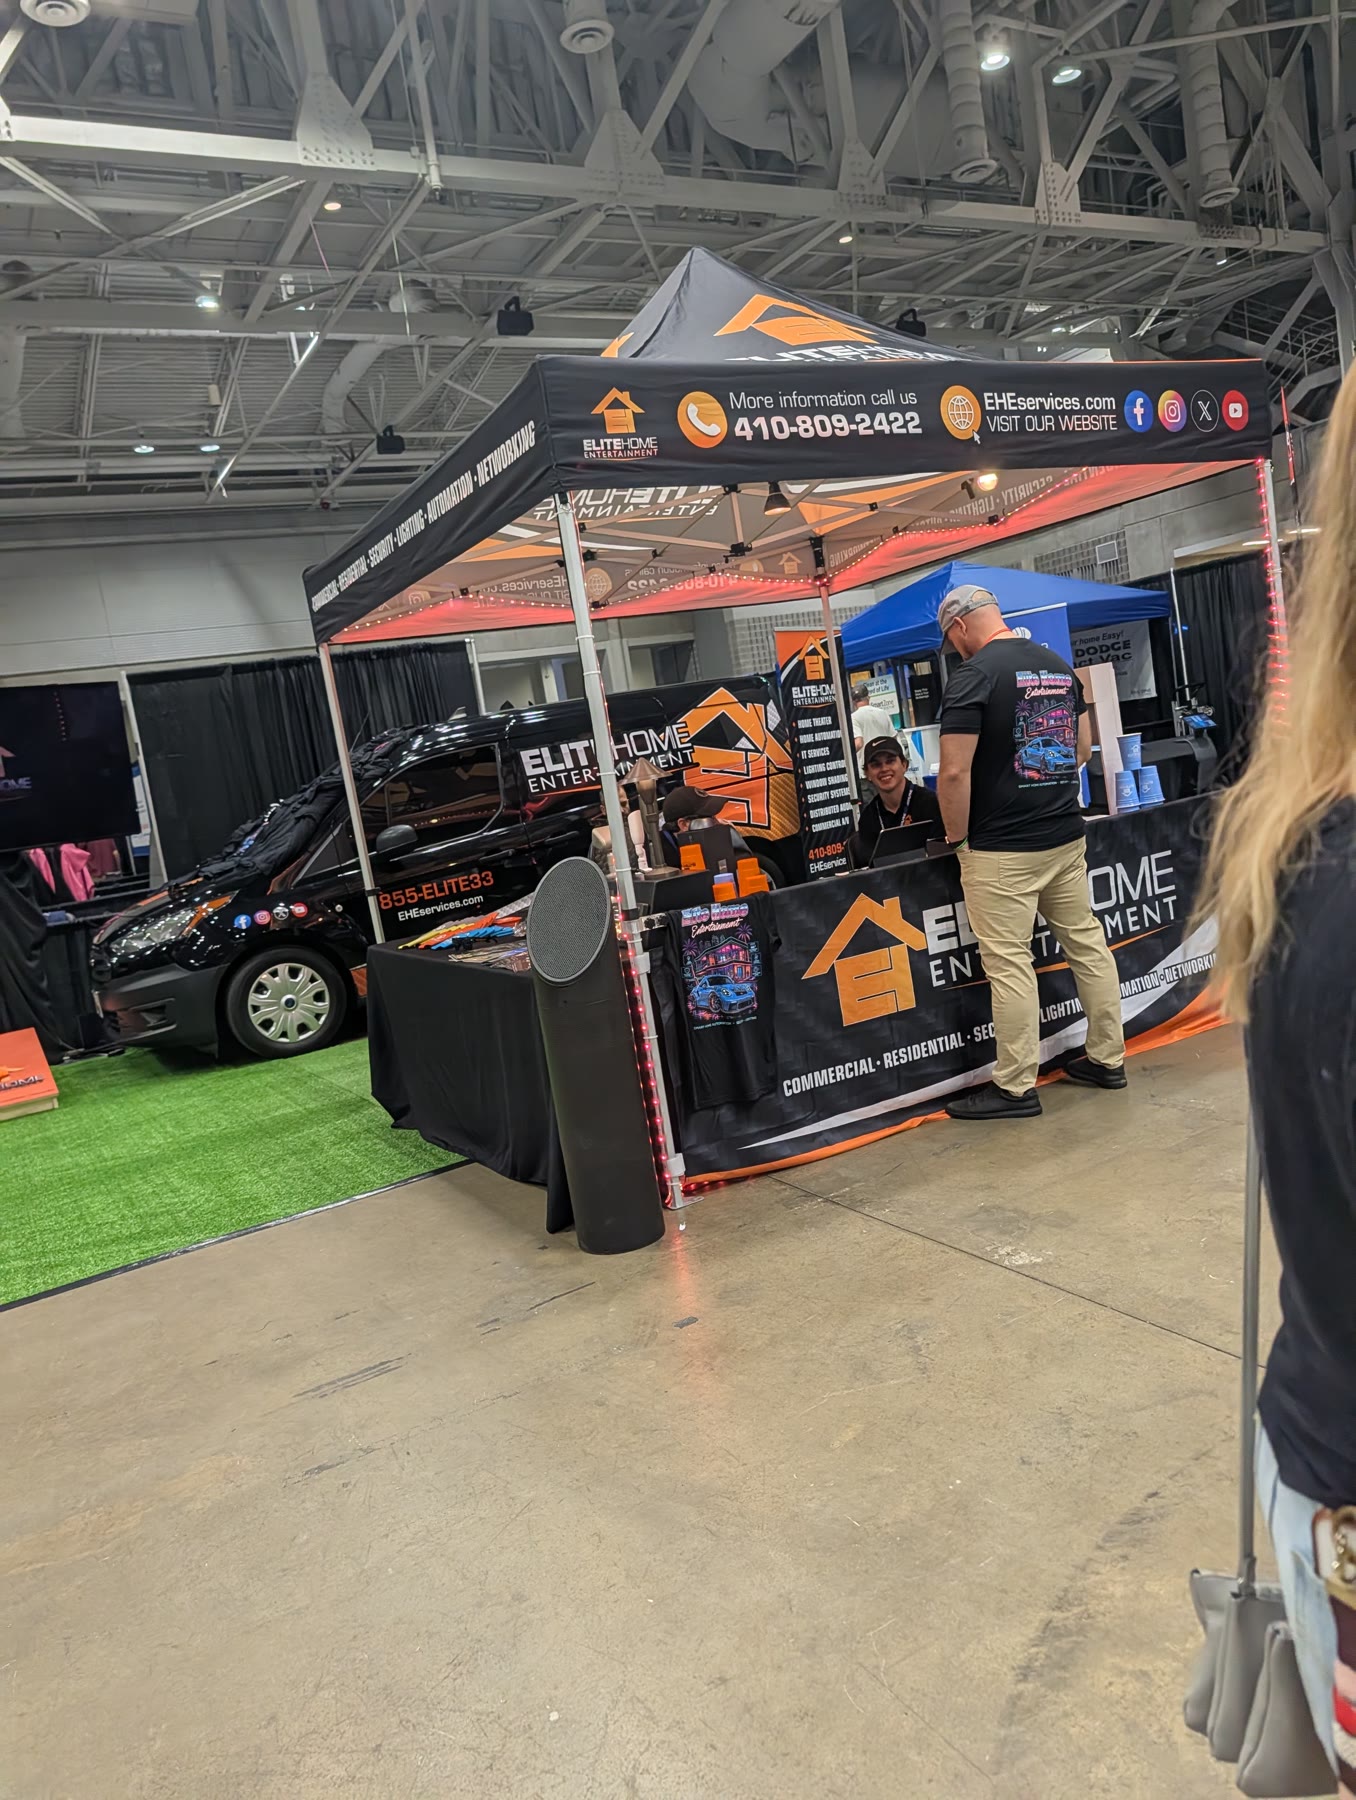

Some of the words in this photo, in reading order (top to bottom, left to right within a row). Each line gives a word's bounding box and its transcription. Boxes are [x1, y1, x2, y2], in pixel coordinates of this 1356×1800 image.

[729, 391, 773, 410] More
[779, 391, 866, 409] information
[870, 390, 896, 406] call
[900, 393, 918, 406] us
[984, 392, 1116, 411] EHEservices.com
[734, 412, 922, 441] 410-809-2422
[987, 416, 1019, 432] VISIT
[1025, 415, 1055, 432] OUR
[1058, 414, 1118, 431] WEBSITE
[583, 436, 658, 451] ELITEHOME
[584, 449, 658, 459] ENTERTAINMENT
[368, 533, 395, 568] SECURITY
[396, 509, 425, 546] LIGHTING
[426, 470, 474, 524] AUTOMATION
[476, 420, 536, 487] NETWORKING
[1075, 640, 1131, 658] DODGE
[792, 684, 836, 699] ELITEHOM
[1025, 687, 1069, 700] Entertainment
[793, 695, 837, 707] ENTERTAINMEN
[797, 718, 813, 729] HOME
[812, 716, 832, 727] THEATER
[799, 733, 814, 744] HOME
[814, 729, 842, 742] AUTOMATIO
[520, 722, 692, 776] ELITHOME
[801, 750, 807, 760] IT
[807, 747, 830, 759] SERVICES
[803, 763, 826, 775] LIGHTING
[826, 759, 846, 771] CONTRO
[807, 791, 830, 803] SECURITY
[379, 871, 495, 910] 855-ELITE33
[398, 895, 484, 921] EHEservices.com
[691, 918, 743, 938] Entertainment
[783, 1057, 876, 1097] COMMERCIAL
[883, 1032, 965, 1069] RESIDENTIAL
[1040, 998, 1084, 1023] LIGHTIN
[1120, 971, 1160, 998] MATION
[1165, 953, 1217, 983] NETWORKI
